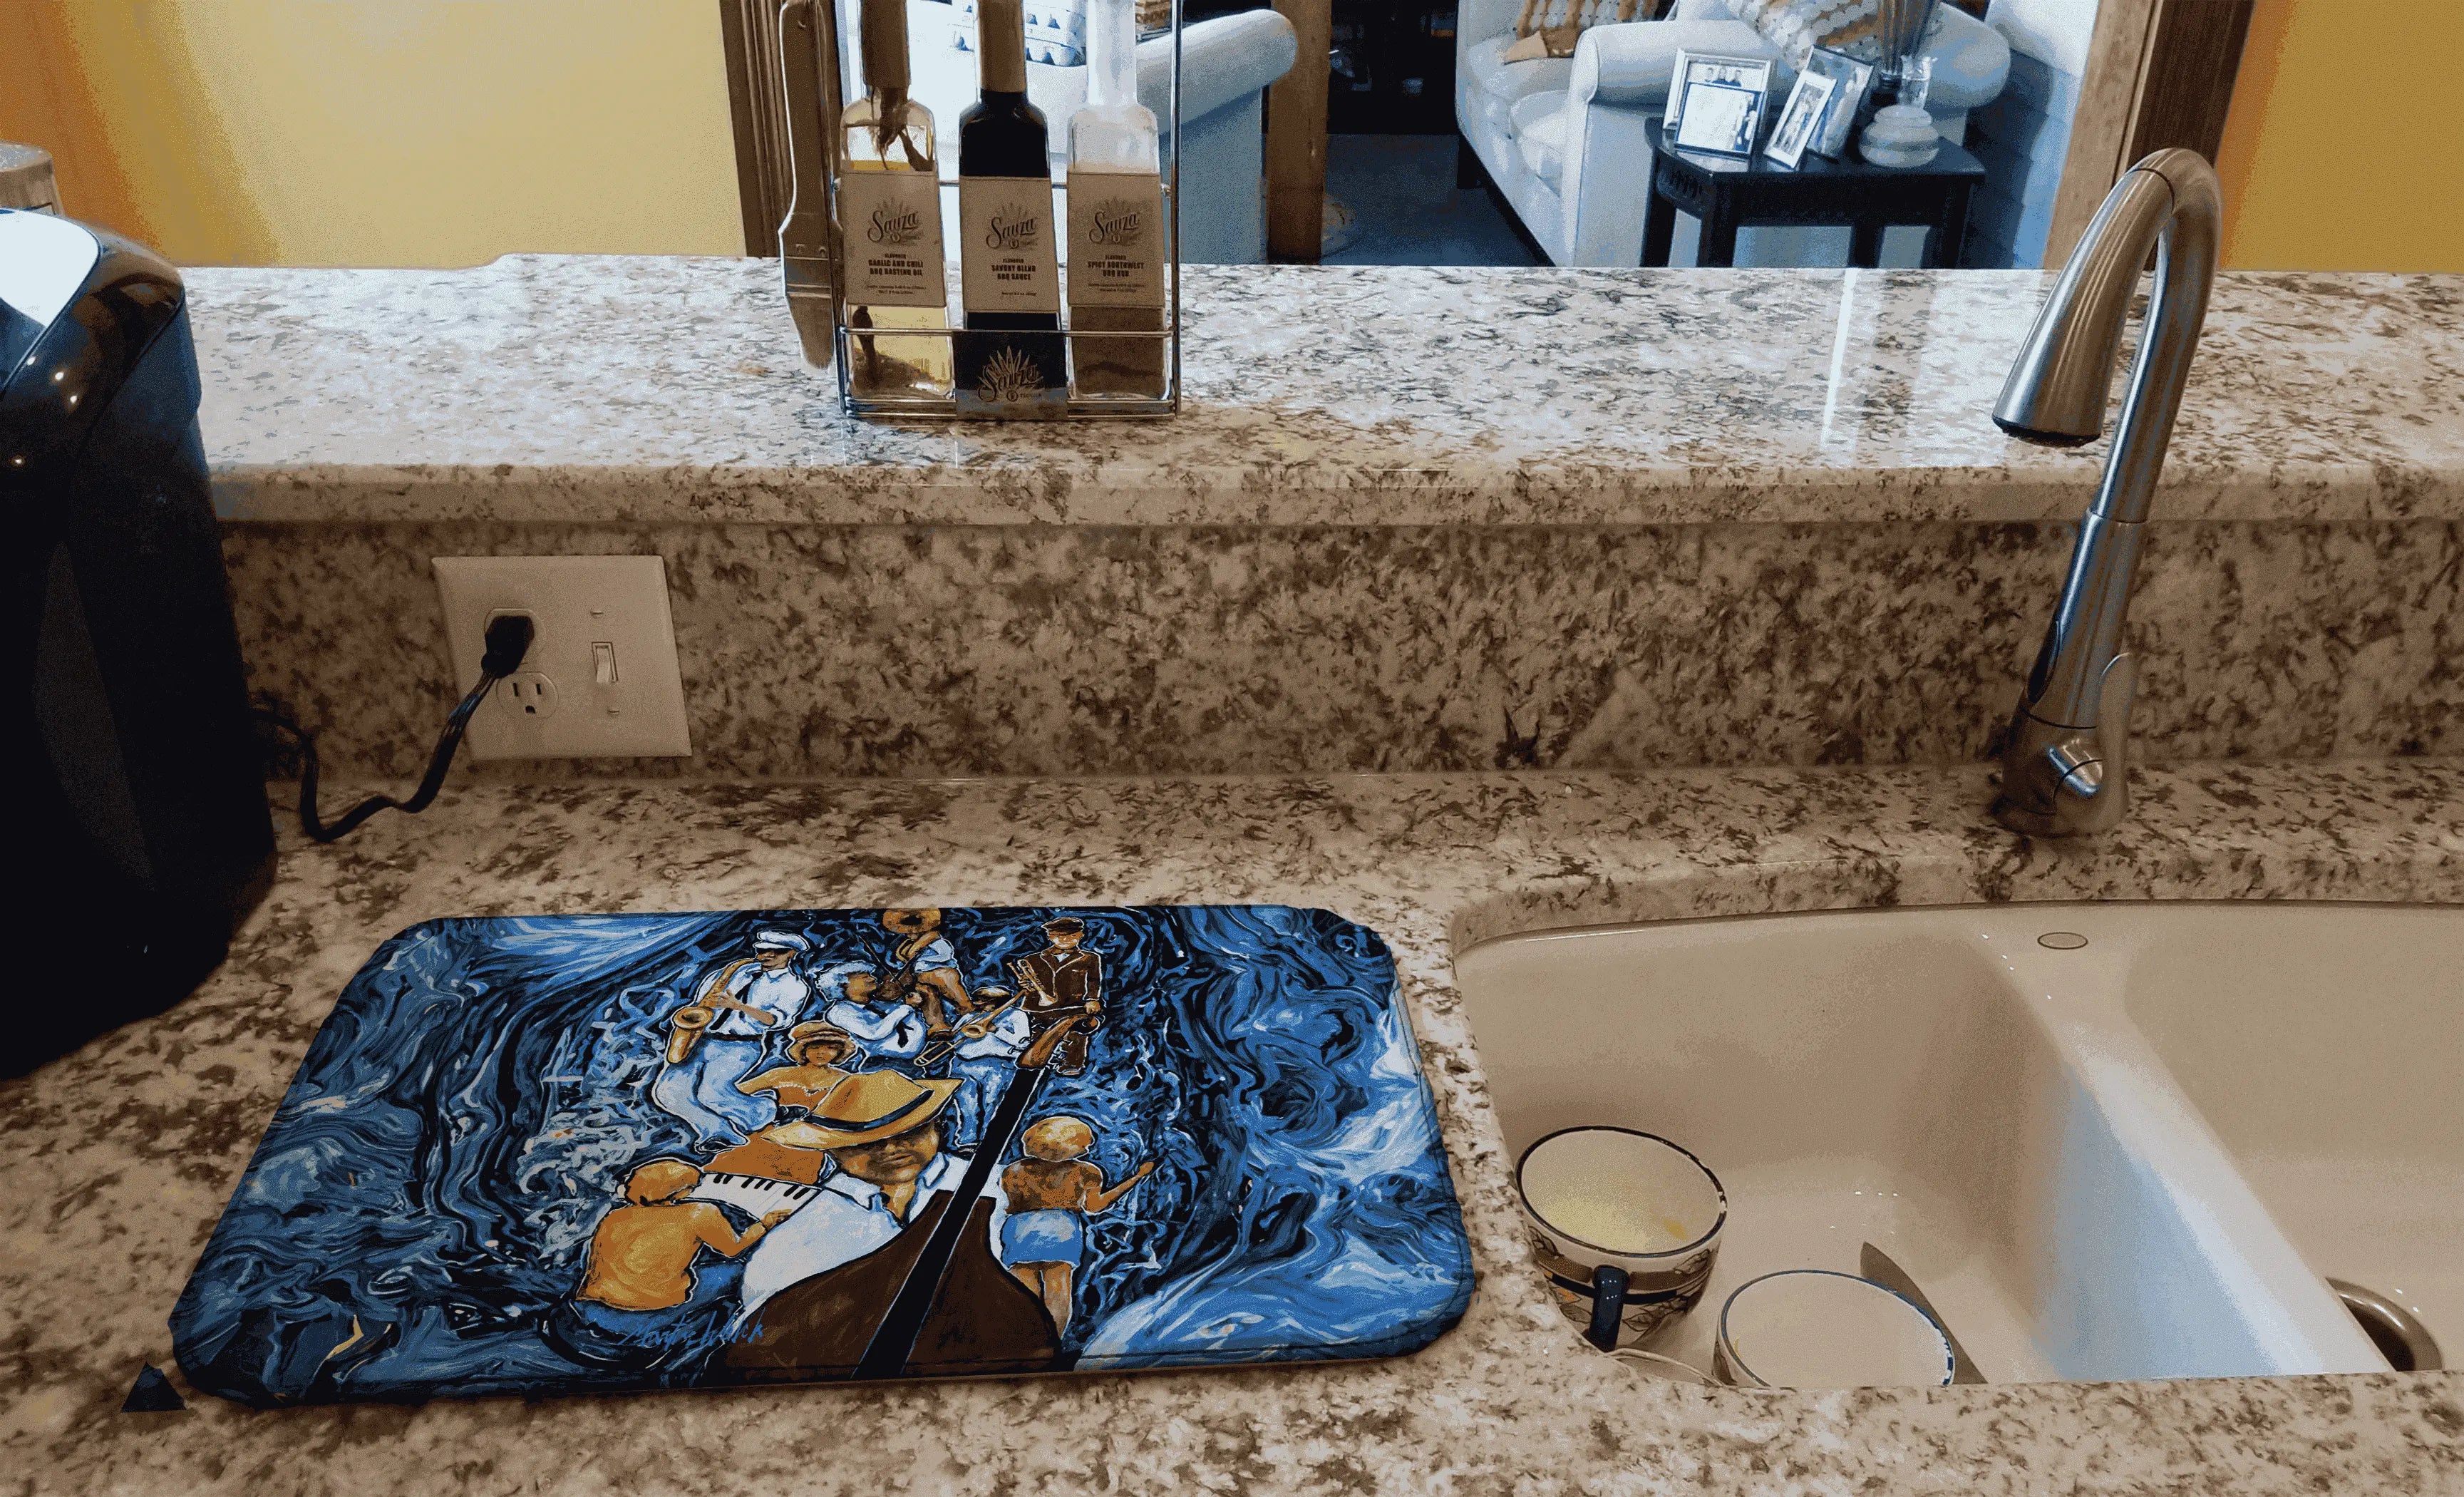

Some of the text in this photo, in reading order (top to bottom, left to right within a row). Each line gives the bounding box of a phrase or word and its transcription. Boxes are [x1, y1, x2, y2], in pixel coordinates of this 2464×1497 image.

[867, 210, 919, 243] Sauza
[986, 216, 1038, 249] Sauza
[1089, 211, 1140, 245] Sauza
